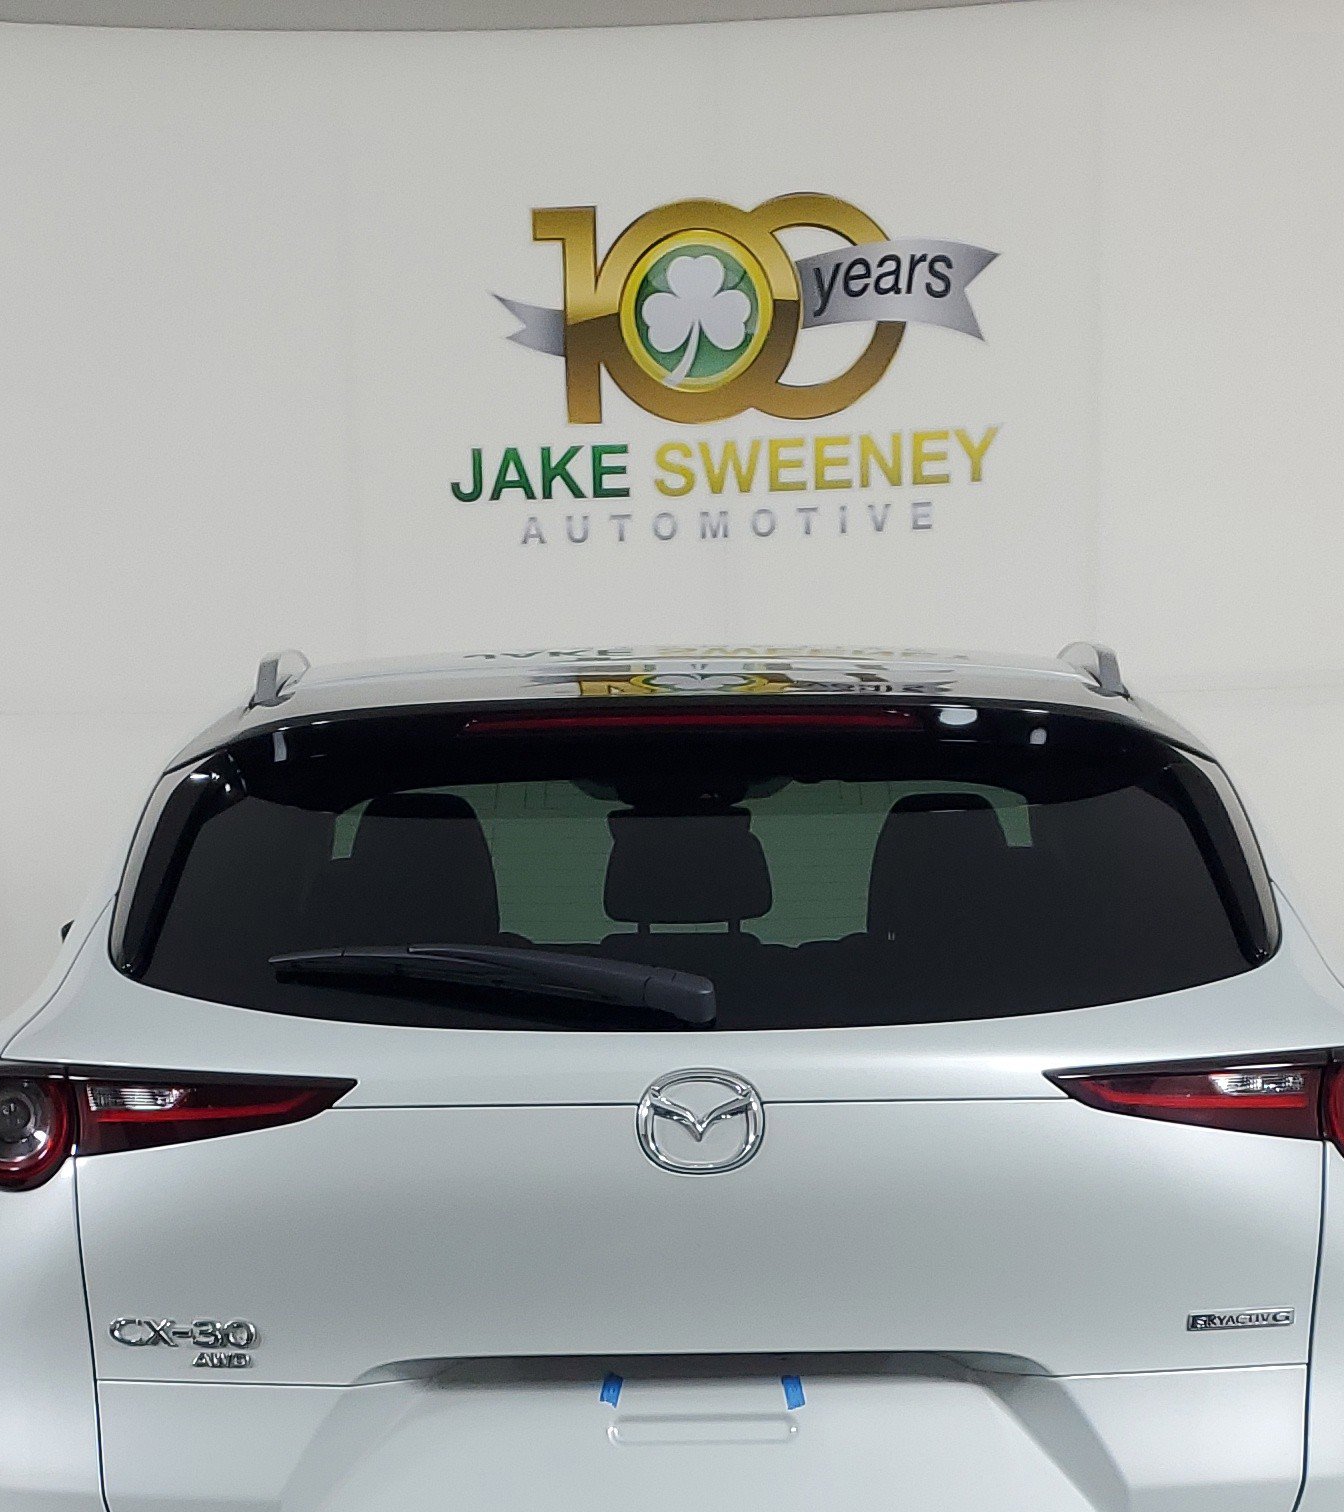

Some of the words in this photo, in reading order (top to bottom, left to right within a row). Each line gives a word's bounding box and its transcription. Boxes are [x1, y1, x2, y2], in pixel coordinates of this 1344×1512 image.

[812, 250, 954, 318] years
[450, 442, 631, 503] JAKE
[653, 423, 999, 498] SWEENEY
[520, 500, 935, 545] AUTOMOTIVE
[109, 1317, 258, 1349] CX-30
[191, 1351, 253, 1369] AWD
